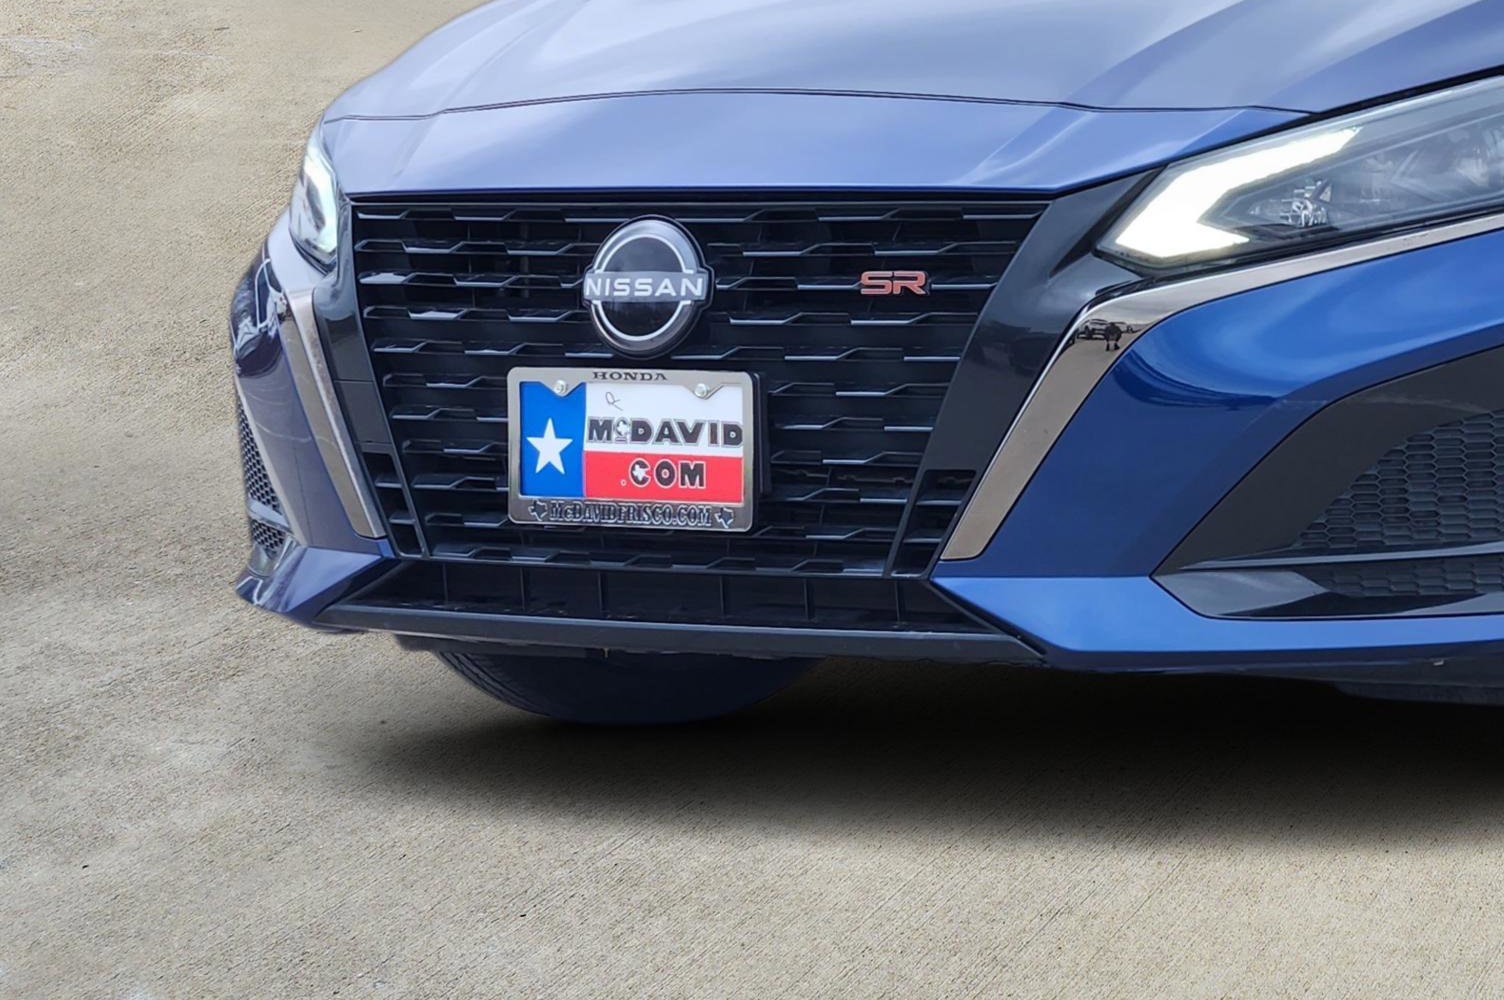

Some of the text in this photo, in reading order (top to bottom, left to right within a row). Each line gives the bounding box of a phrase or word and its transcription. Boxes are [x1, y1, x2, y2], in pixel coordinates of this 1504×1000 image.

[585, 276, 704, 298] NISSAN
[860, 270, 927, 295] SR
[592, 371, 668, 382] HONDA
